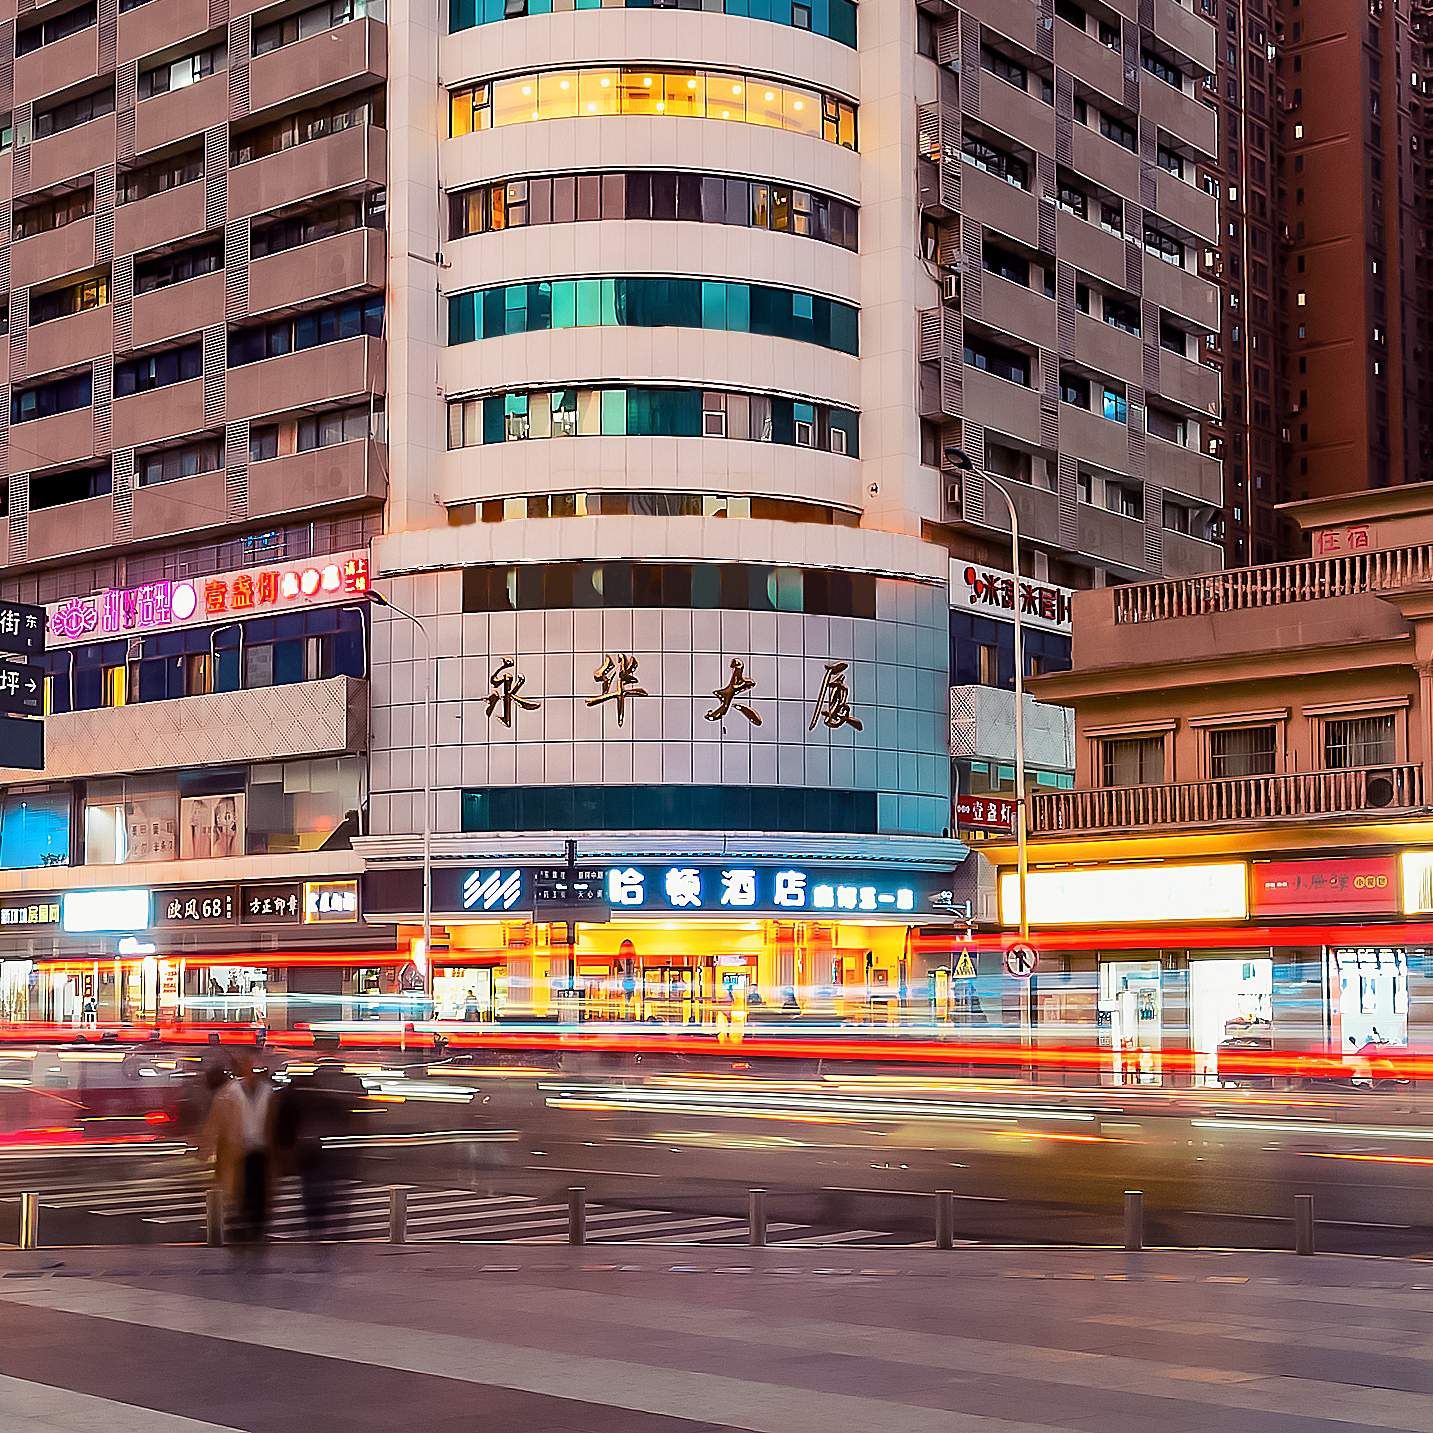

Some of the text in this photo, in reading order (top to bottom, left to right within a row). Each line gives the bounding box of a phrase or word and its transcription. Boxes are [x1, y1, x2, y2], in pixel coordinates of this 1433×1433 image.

[1317, 524, 1369, 554] 住宿
[204, 570, 280, 614] 壹盏灯
[0, 609, 38, 636] 街 东
[0, 669, 20, 696] 坪
[480, 652, 864, 732] 永华大厦
[555, 868, 807, 907] 哈顿酒店
